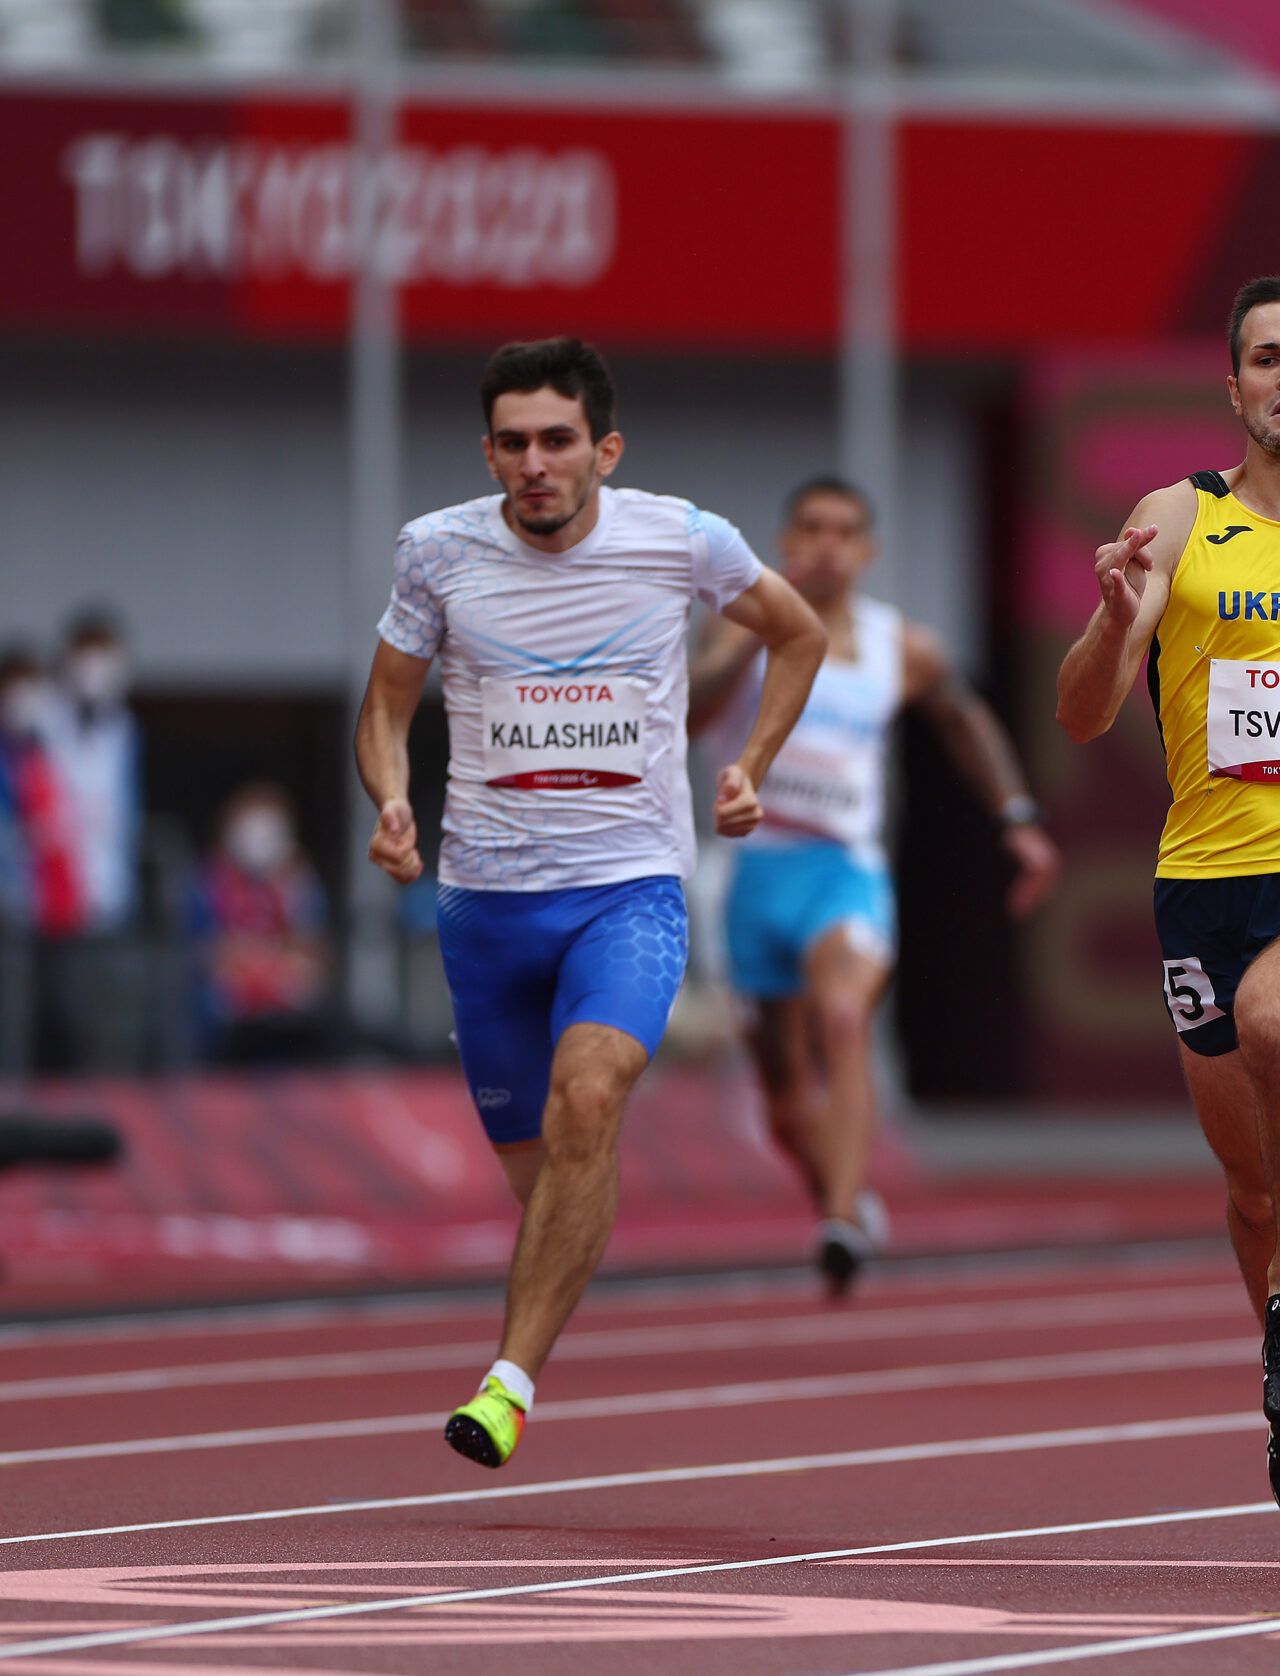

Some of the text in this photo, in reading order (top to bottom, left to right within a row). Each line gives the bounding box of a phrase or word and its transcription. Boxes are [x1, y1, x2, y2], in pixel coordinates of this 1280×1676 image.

[515, 685, 613, 703] TOYOTA
[491, 720, 639, 748] KALASHIAN
[1168, 966, 1204, 1020] 5
